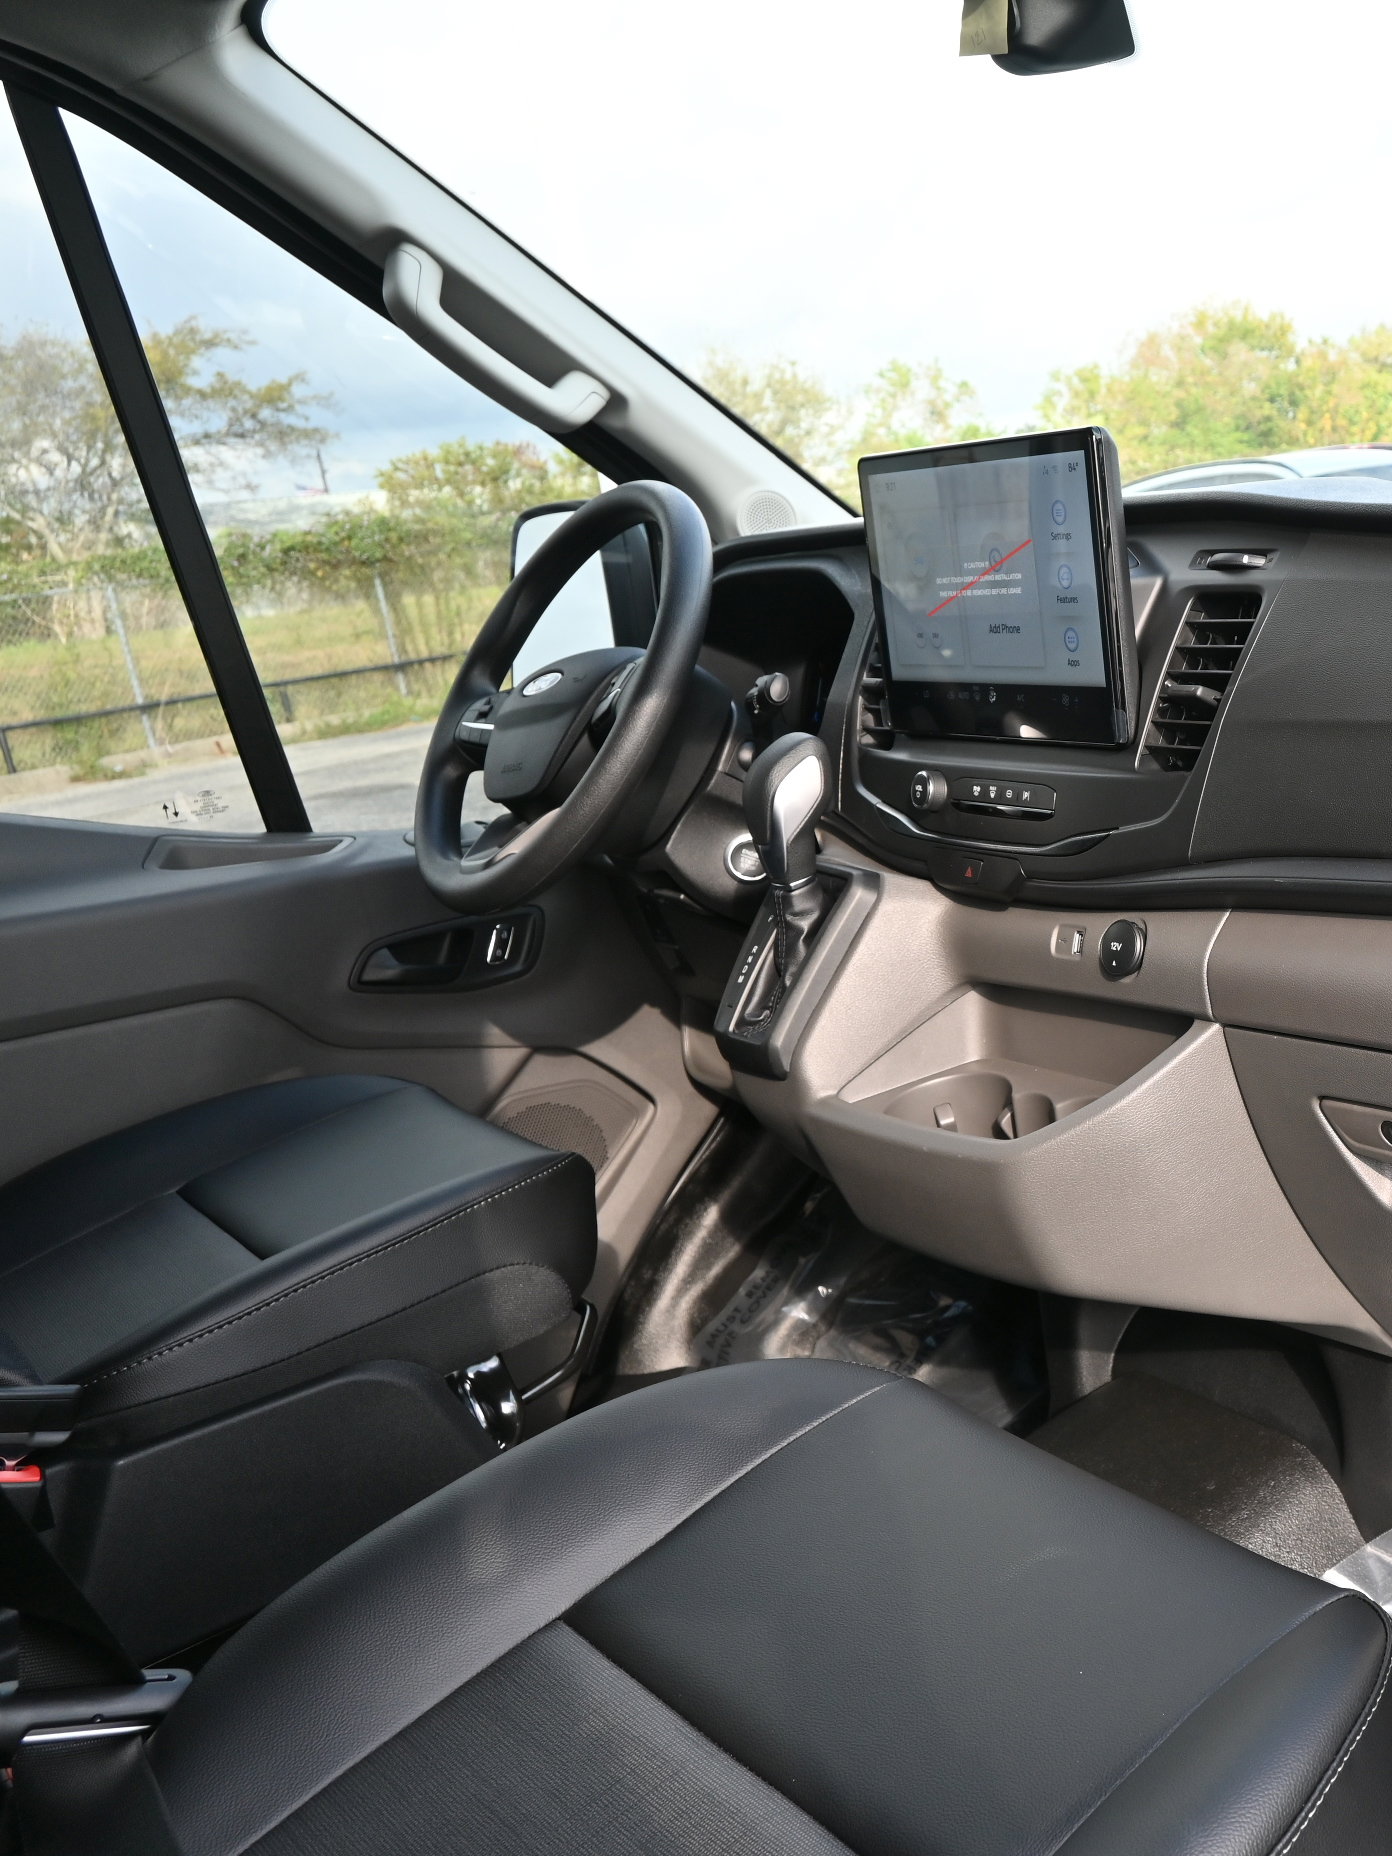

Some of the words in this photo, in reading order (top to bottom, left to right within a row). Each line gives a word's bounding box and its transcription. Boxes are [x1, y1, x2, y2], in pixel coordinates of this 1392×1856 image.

[1050, 532, 1072, 541] Settings
[995, 573, 1022, 581] INSTALLATION
[1056, 595, 1079, 604] Features
[989, 624, 1001, 634] Add
[1002, 624, 1021, 634] Phone
[1067, 658, 1080, 667] Apps
[1110, 942, 1123, 951] 12V
